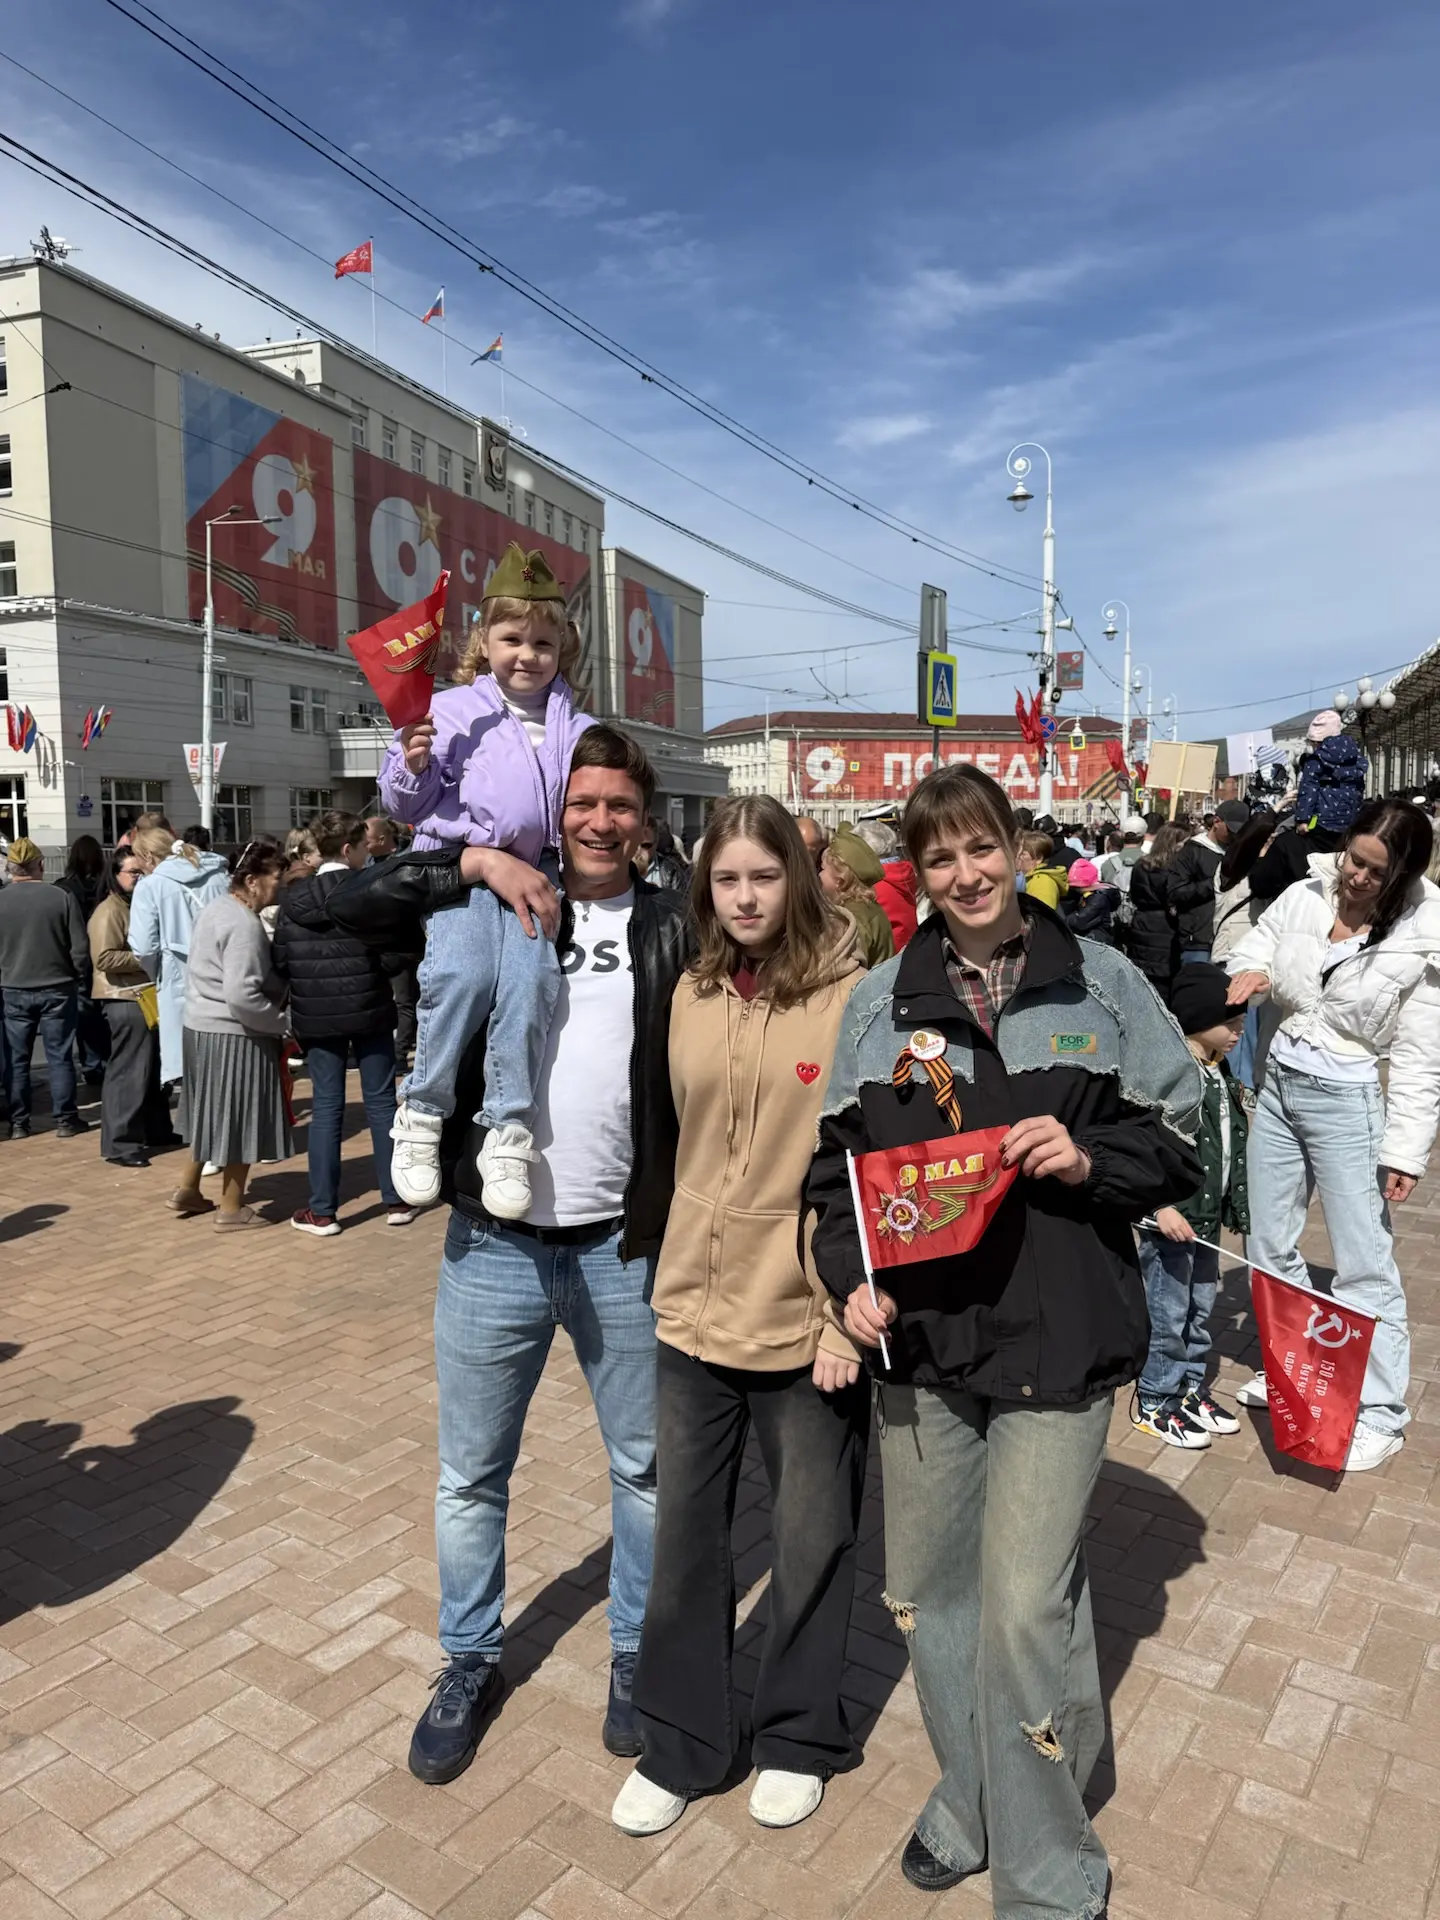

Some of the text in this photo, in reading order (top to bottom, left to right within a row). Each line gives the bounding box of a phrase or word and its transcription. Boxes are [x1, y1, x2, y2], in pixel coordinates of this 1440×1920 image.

[252, 454, 317, 568] 9
[287, 549, 326, 580] МАЯ
[628, 607, 653, 677] 9
[806, 746, 846, 793] 9
[884, 752, 1079, 794] ПОЕД!
[826, 783, 851, 794] МАЯ
[1060, 1035, 1084, 1045] FOR
[899, 1152, 985, 1187] 9 МАЯ
[1318, 1360, 1336, 1379] 150
